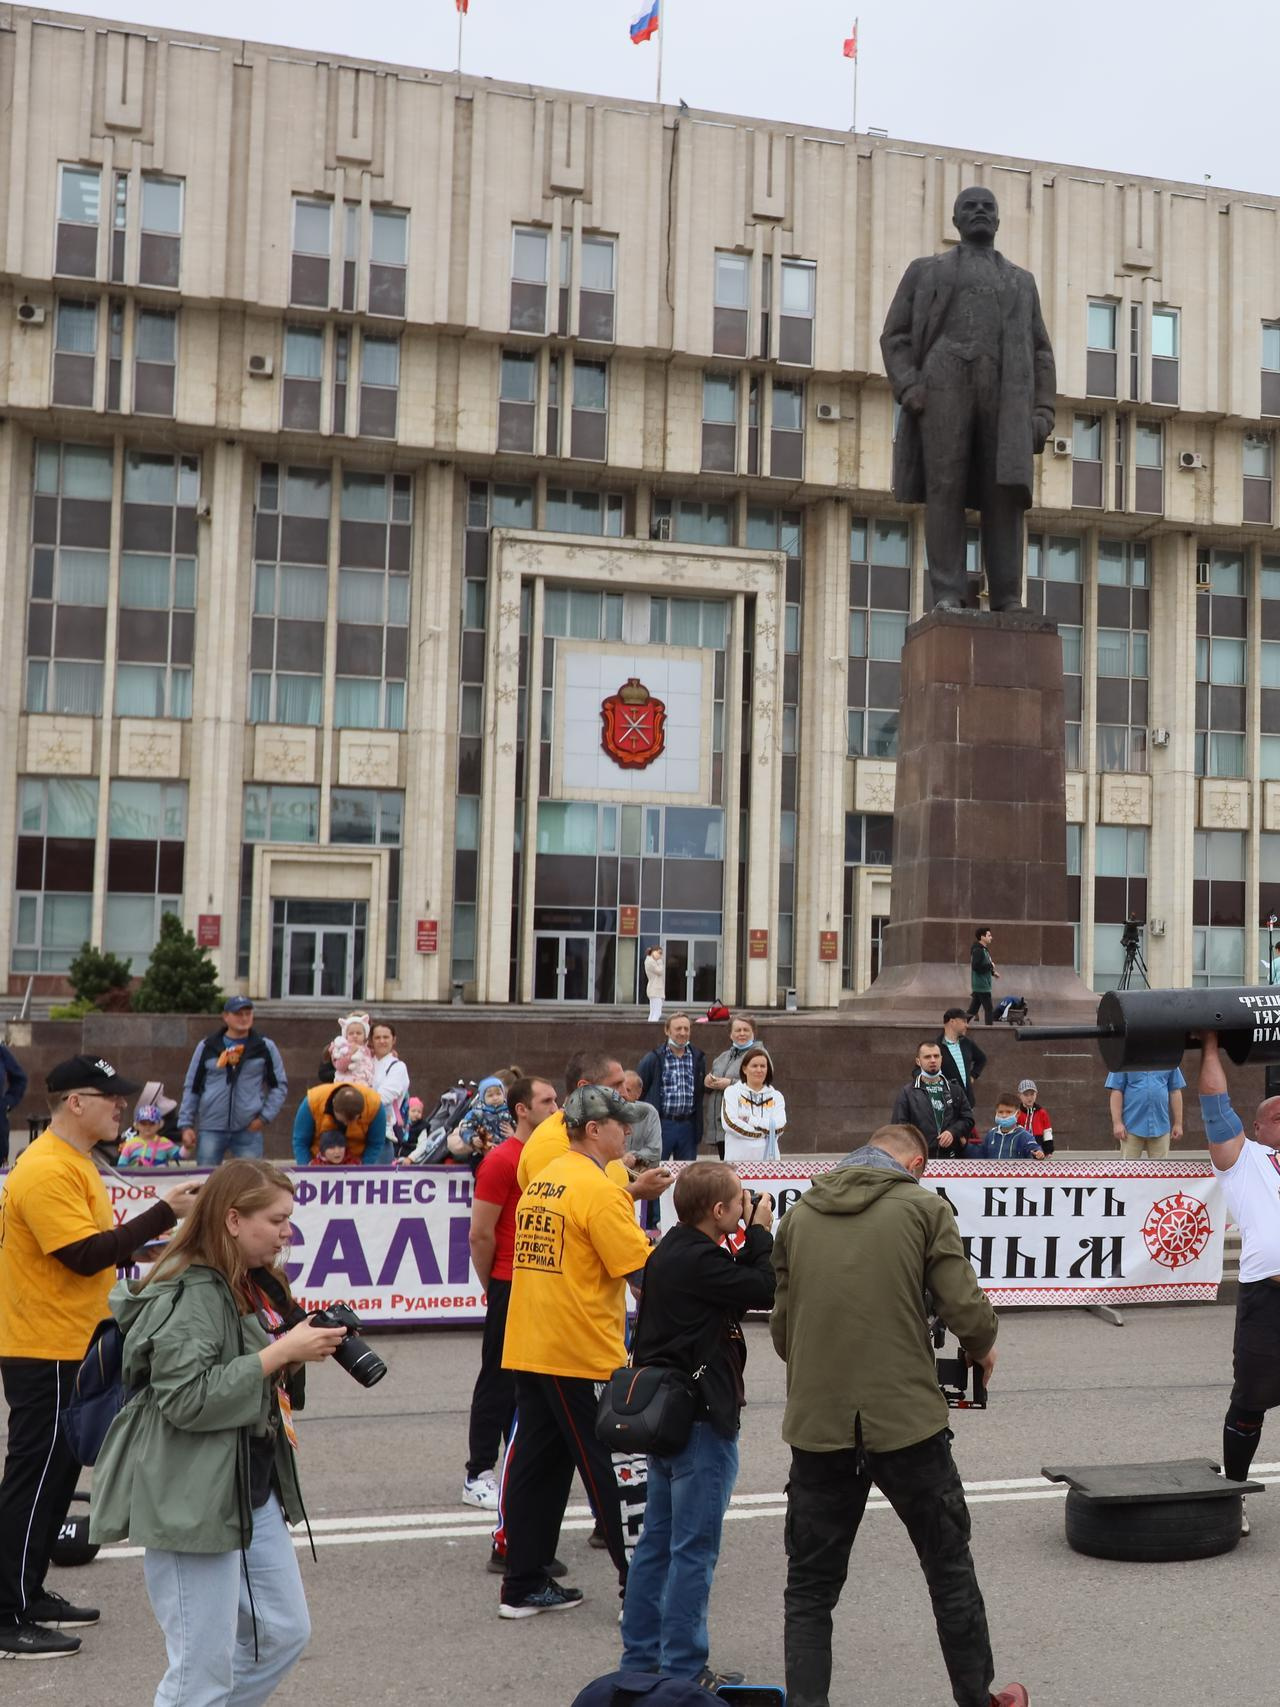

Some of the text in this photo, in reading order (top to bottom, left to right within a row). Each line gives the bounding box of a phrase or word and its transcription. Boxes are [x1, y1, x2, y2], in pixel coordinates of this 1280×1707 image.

[106, 1184, 156, 1205] ров
[293, 1178, 472, 1208] ФИТНЕС Ц
[526, 1181, 567, 1199] СУДЬЯ
[981, 1186, 1127, 1217] БЫТЬ
[960, 1236, 1126, 1279] НЫМ
[390, 1294, 477, 1313] Руднева
[57, 1523, 77, 1540] 24
